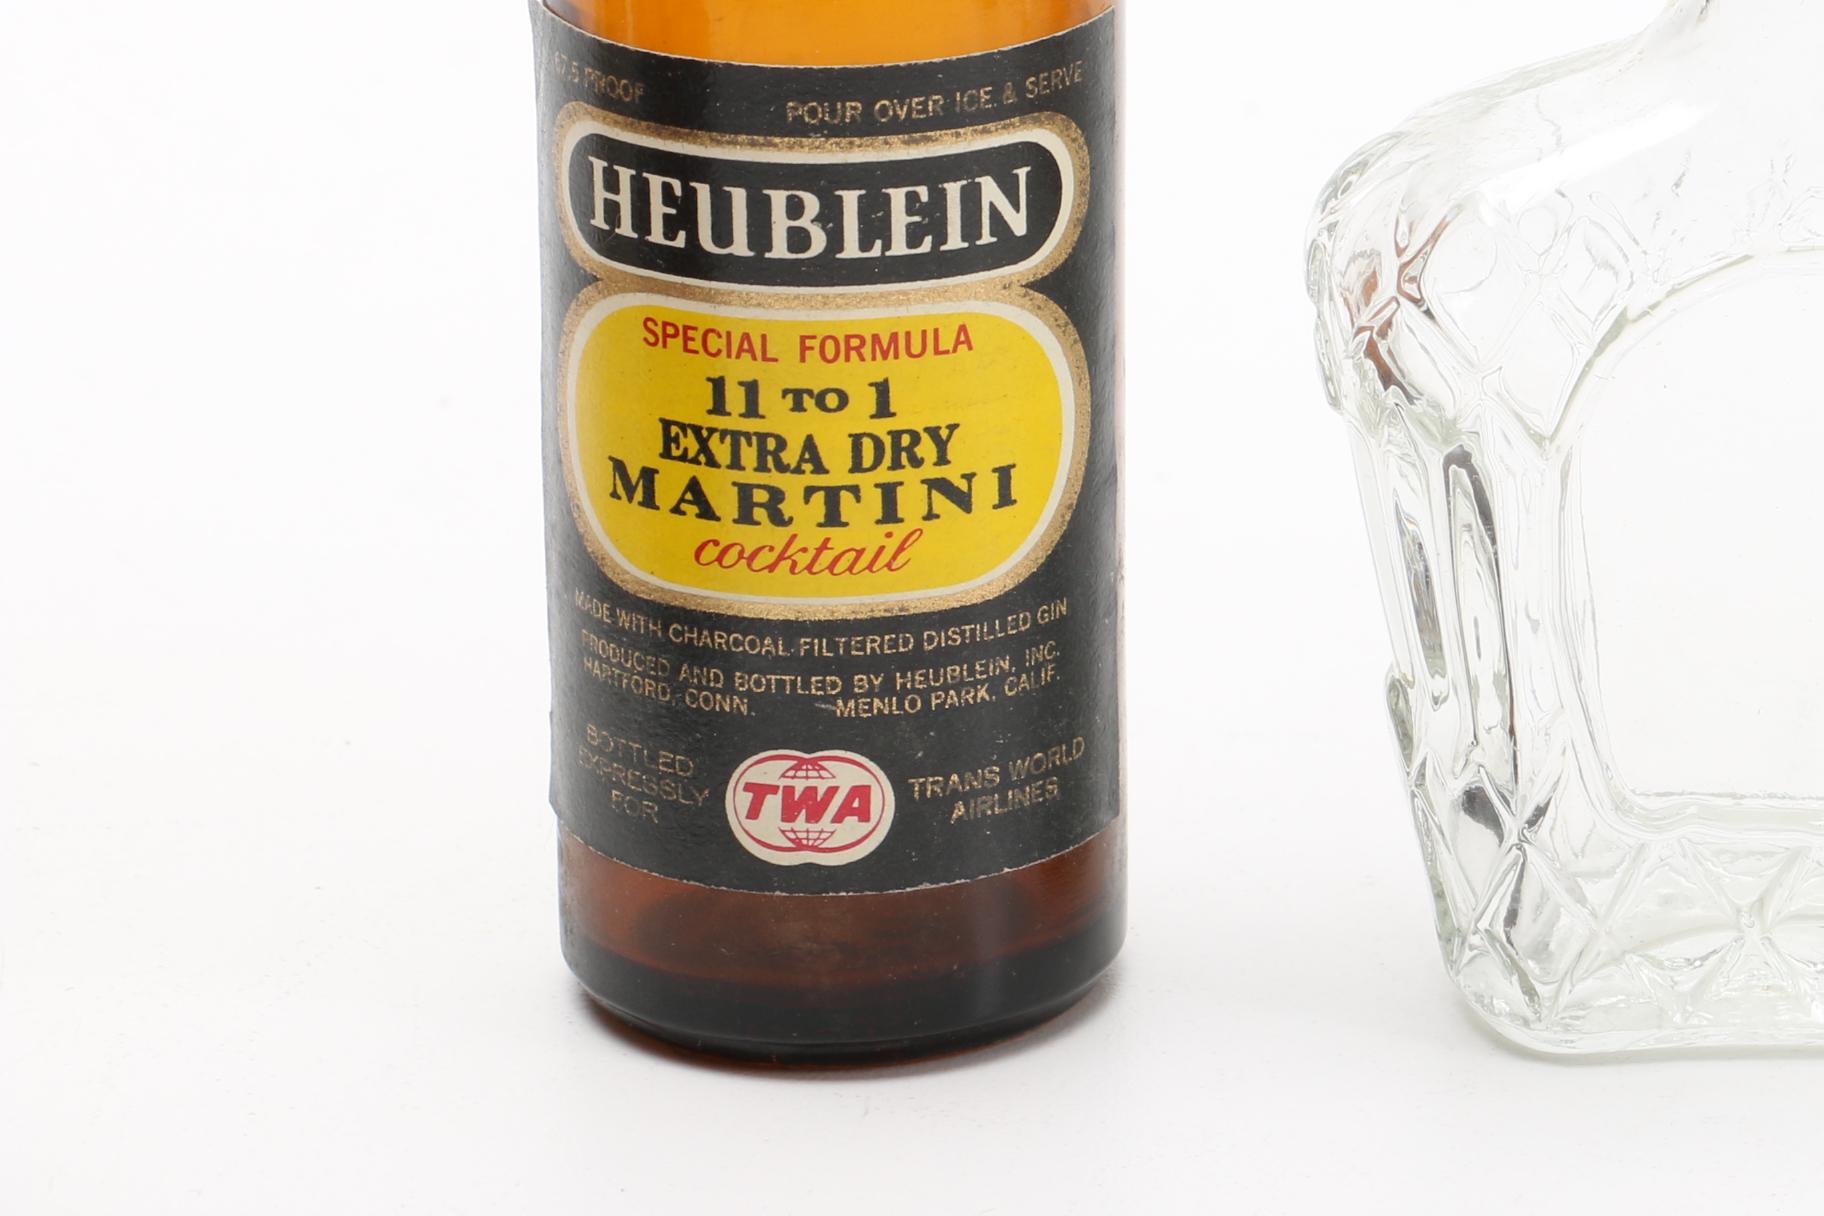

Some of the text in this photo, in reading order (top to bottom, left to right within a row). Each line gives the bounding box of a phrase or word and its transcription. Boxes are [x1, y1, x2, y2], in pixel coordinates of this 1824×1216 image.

[583, 67, 646, 104] PROOF
[785, 101, 862, 124] POUR
[874, 95, 944, 122] OVER
[1025, 60, 1083, 99] SERVE
[587, 154, 1032, 260] HEUBLEIN
[642, 317, 973, 363] SPECIAL FORMULA
[706, 376, 897, 419] 11 TO 1
[658, 418, 960, 475] EXTRA DRY
[608, 456, 1017, 529] MARTINI
[694, 528, 923, 577] cocktail
[575, 588, 612, 623] MADE
[617, 609, 662, 637] WITH
[800, 633, 914, 657] FILTERED
[923, 611, 1031, 652] DISTILLED
[1037, 598, 1068, 624] GIN
[581, 629, 670, 677] PRODUCED
[679, 664, 724, 689] AND
[735, 672, 842, 695] BOTTLED
[854, 673, 884, 693] BY
[1025, 641, 1060, 666] INC.
[836, 695, 921, 718] MENLO
[1004, 664, 1060, 697] CALIF.
[586, 723, 694, 777] BOTTLED
[908, 736, 1085, 801] TRANS WORLD
[611, 789, 658, 824] FOR
[742, 783, 873, 824] TWA
[951, 776, 1059, 824] AIRLINES
